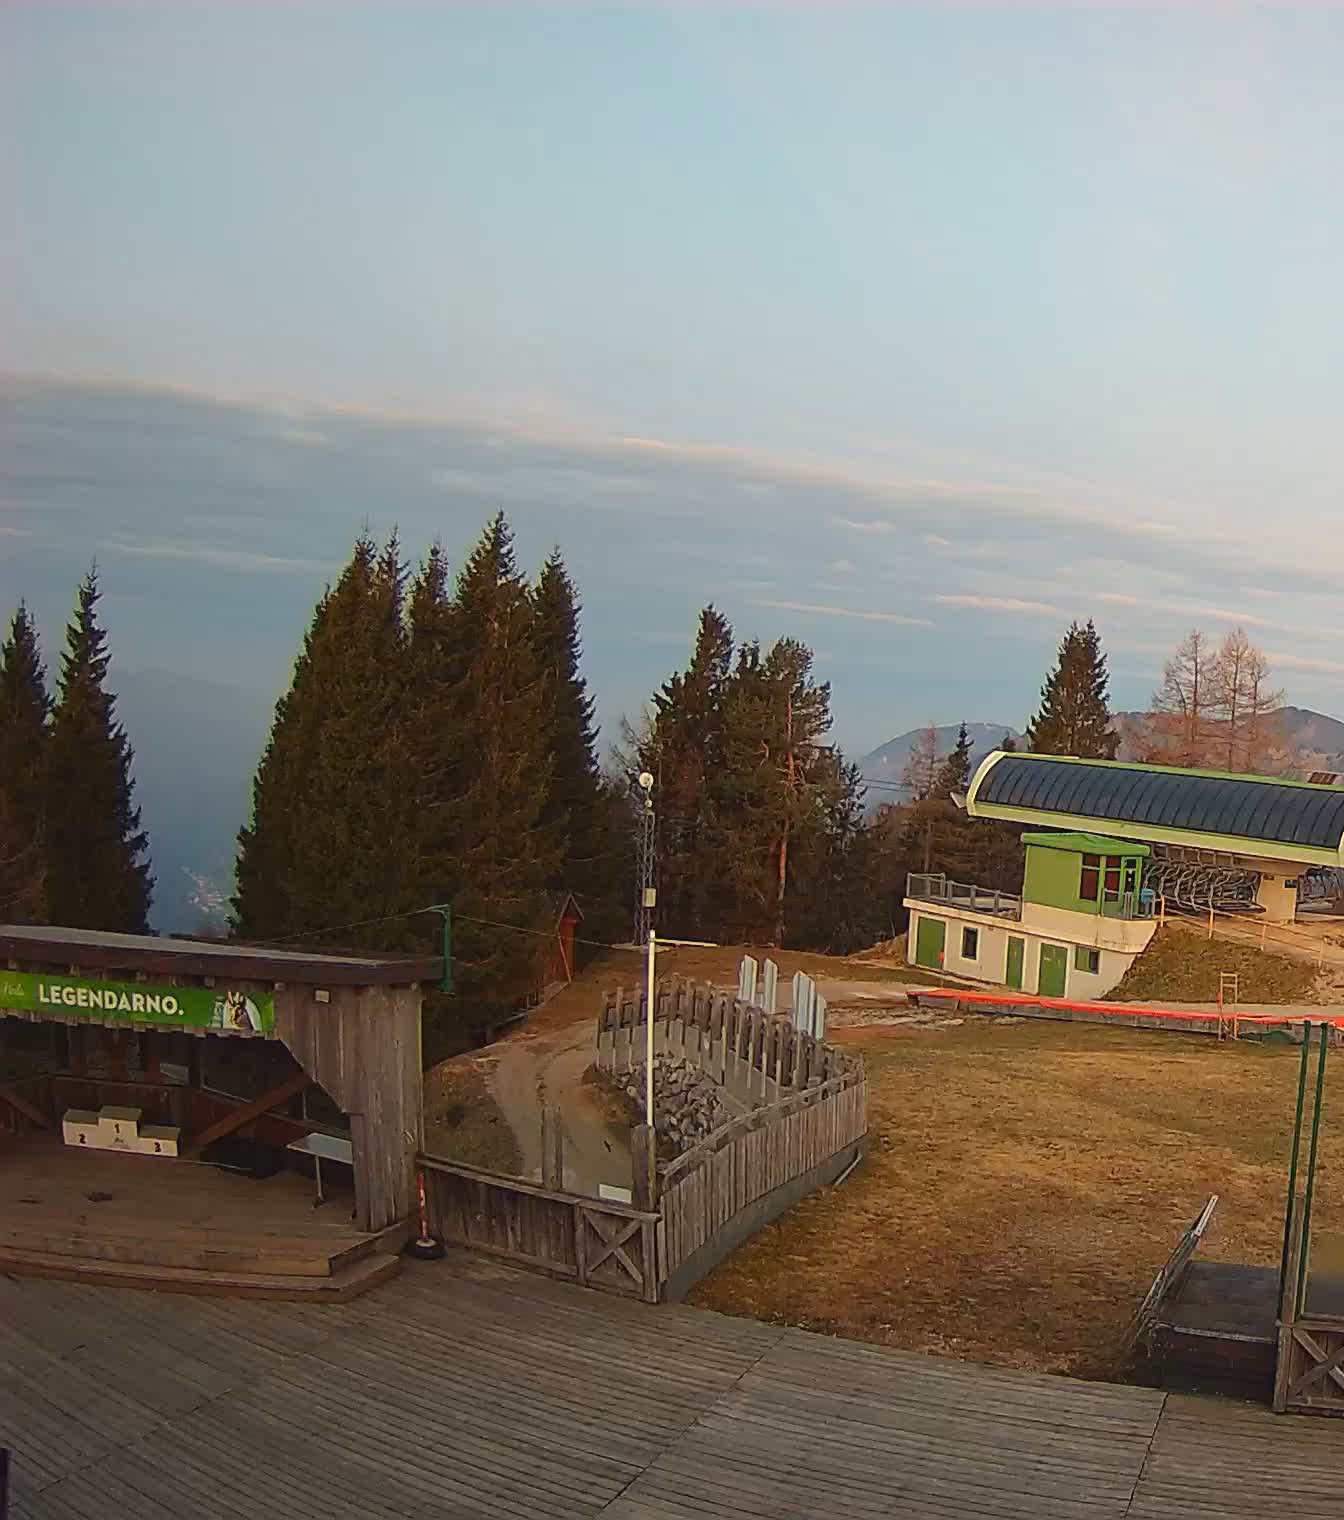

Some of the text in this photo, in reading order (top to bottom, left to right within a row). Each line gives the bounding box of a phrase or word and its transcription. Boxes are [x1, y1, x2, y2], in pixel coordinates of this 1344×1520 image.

[38, 983, 185, 1016] LEGENDARNO.
[114, 1123, 121, 1134] 1
[78, 1133, 86, 1144] 2
[153, 1142, 162, 1153] 3
